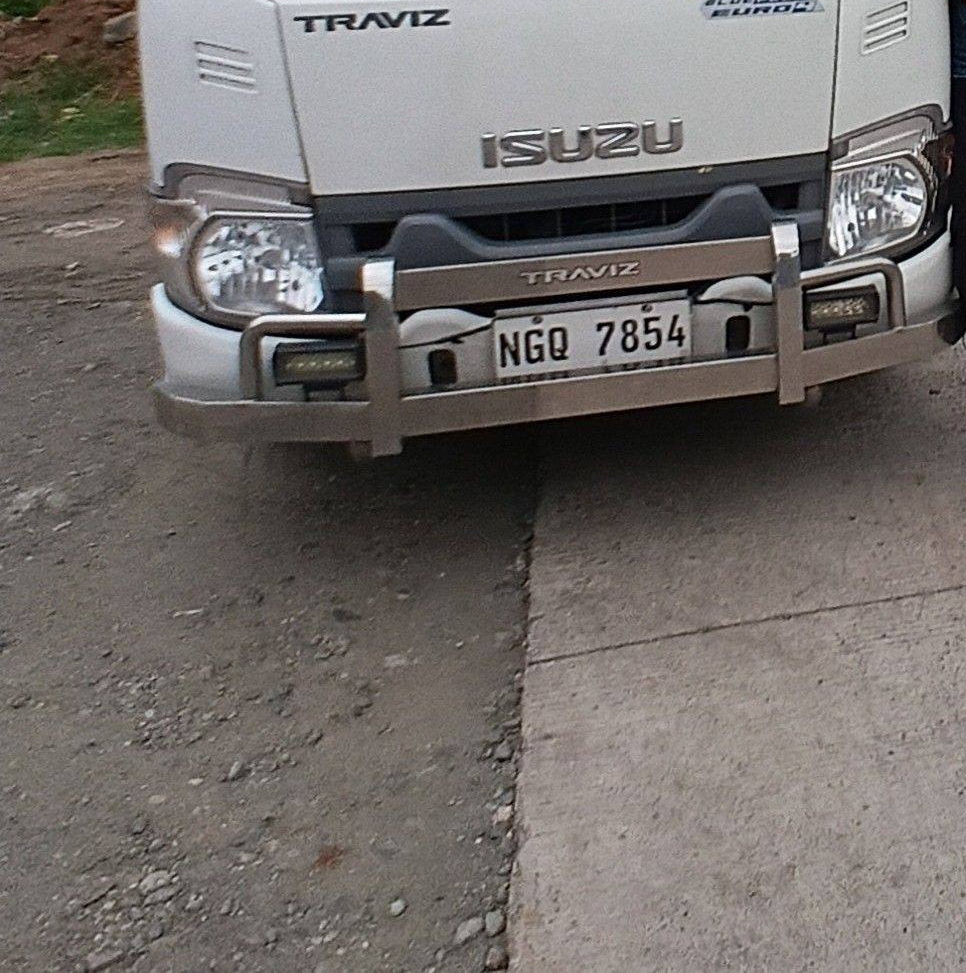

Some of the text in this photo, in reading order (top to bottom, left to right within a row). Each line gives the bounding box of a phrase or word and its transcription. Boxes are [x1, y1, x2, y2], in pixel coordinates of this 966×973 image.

[293, 8, 451, 33] TRAVIZ
[481, 117, 684, 169] ISUZU
[520, 260, 641, 285] TRAVIZ
[499, 314, 686, 368] NGQ 7854
